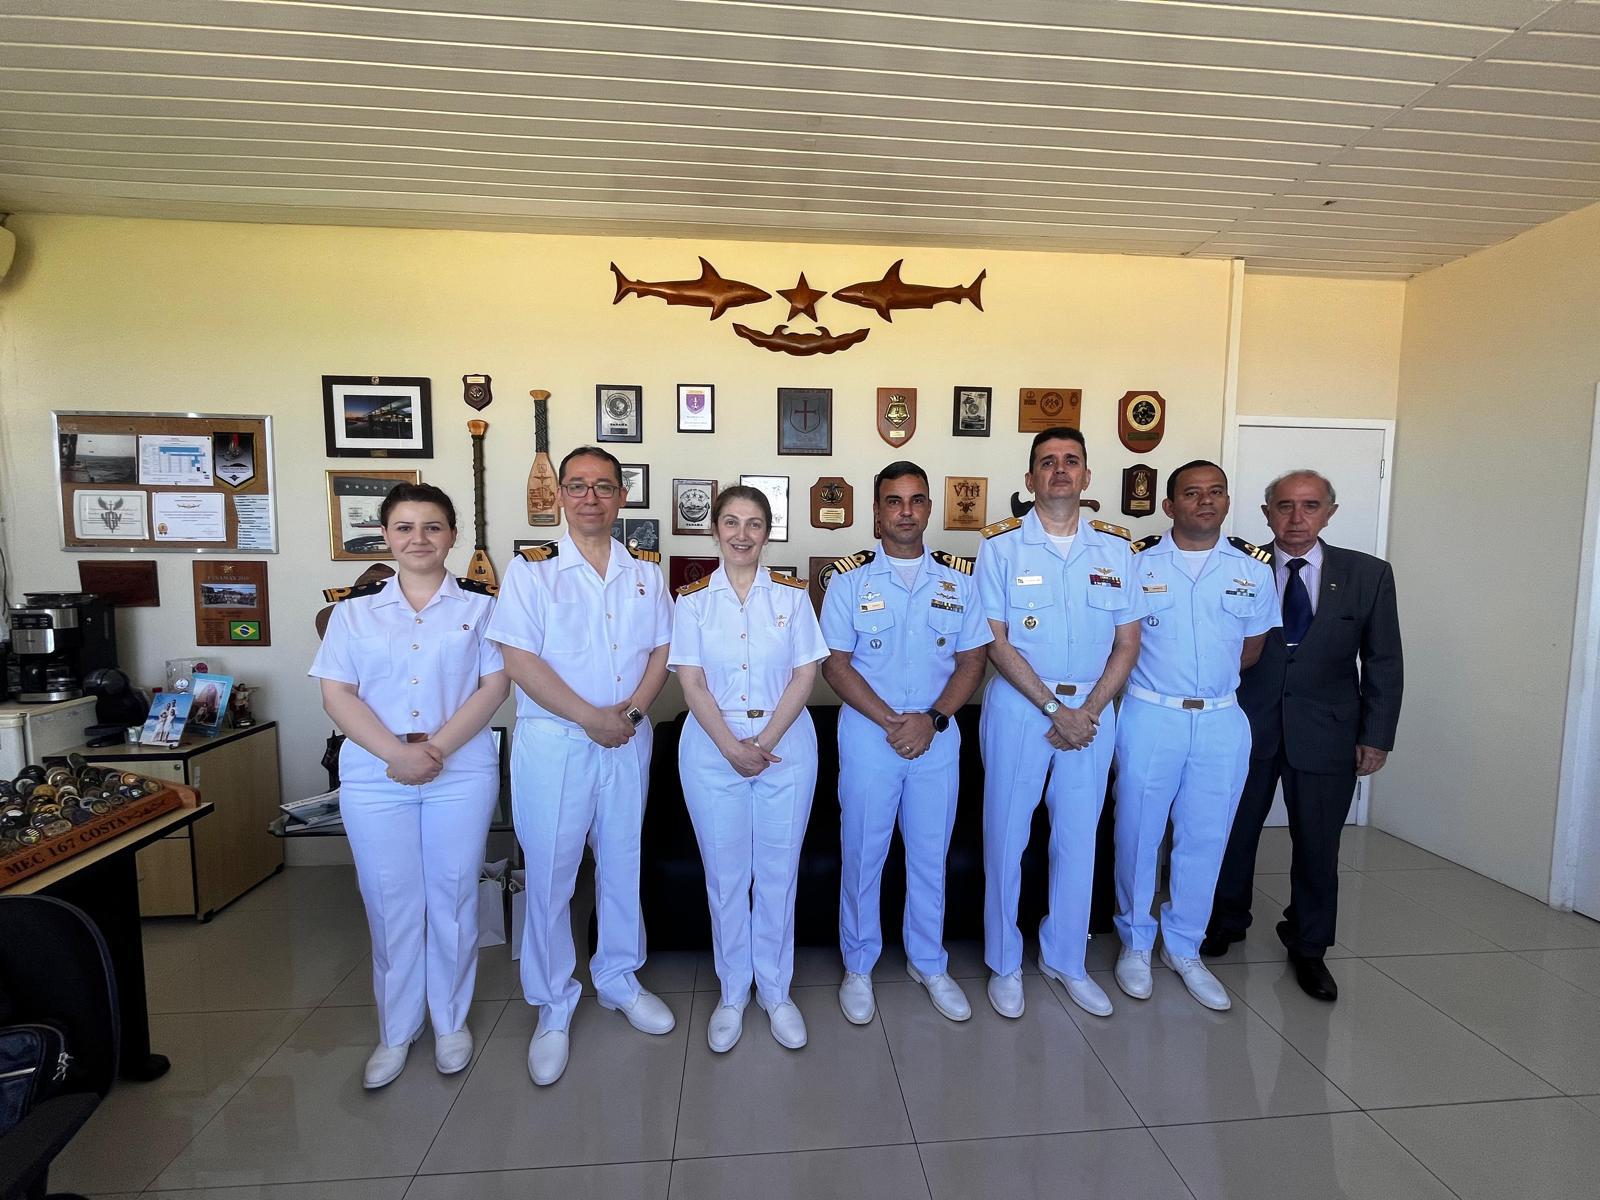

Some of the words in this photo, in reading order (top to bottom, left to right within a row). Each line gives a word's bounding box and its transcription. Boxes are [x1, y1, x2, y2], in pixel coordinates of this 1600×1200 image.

[6, 852, 45, 875] MEC
[50, 839, 77, 857] 167
[79, 818, 127, 841] COSTA
